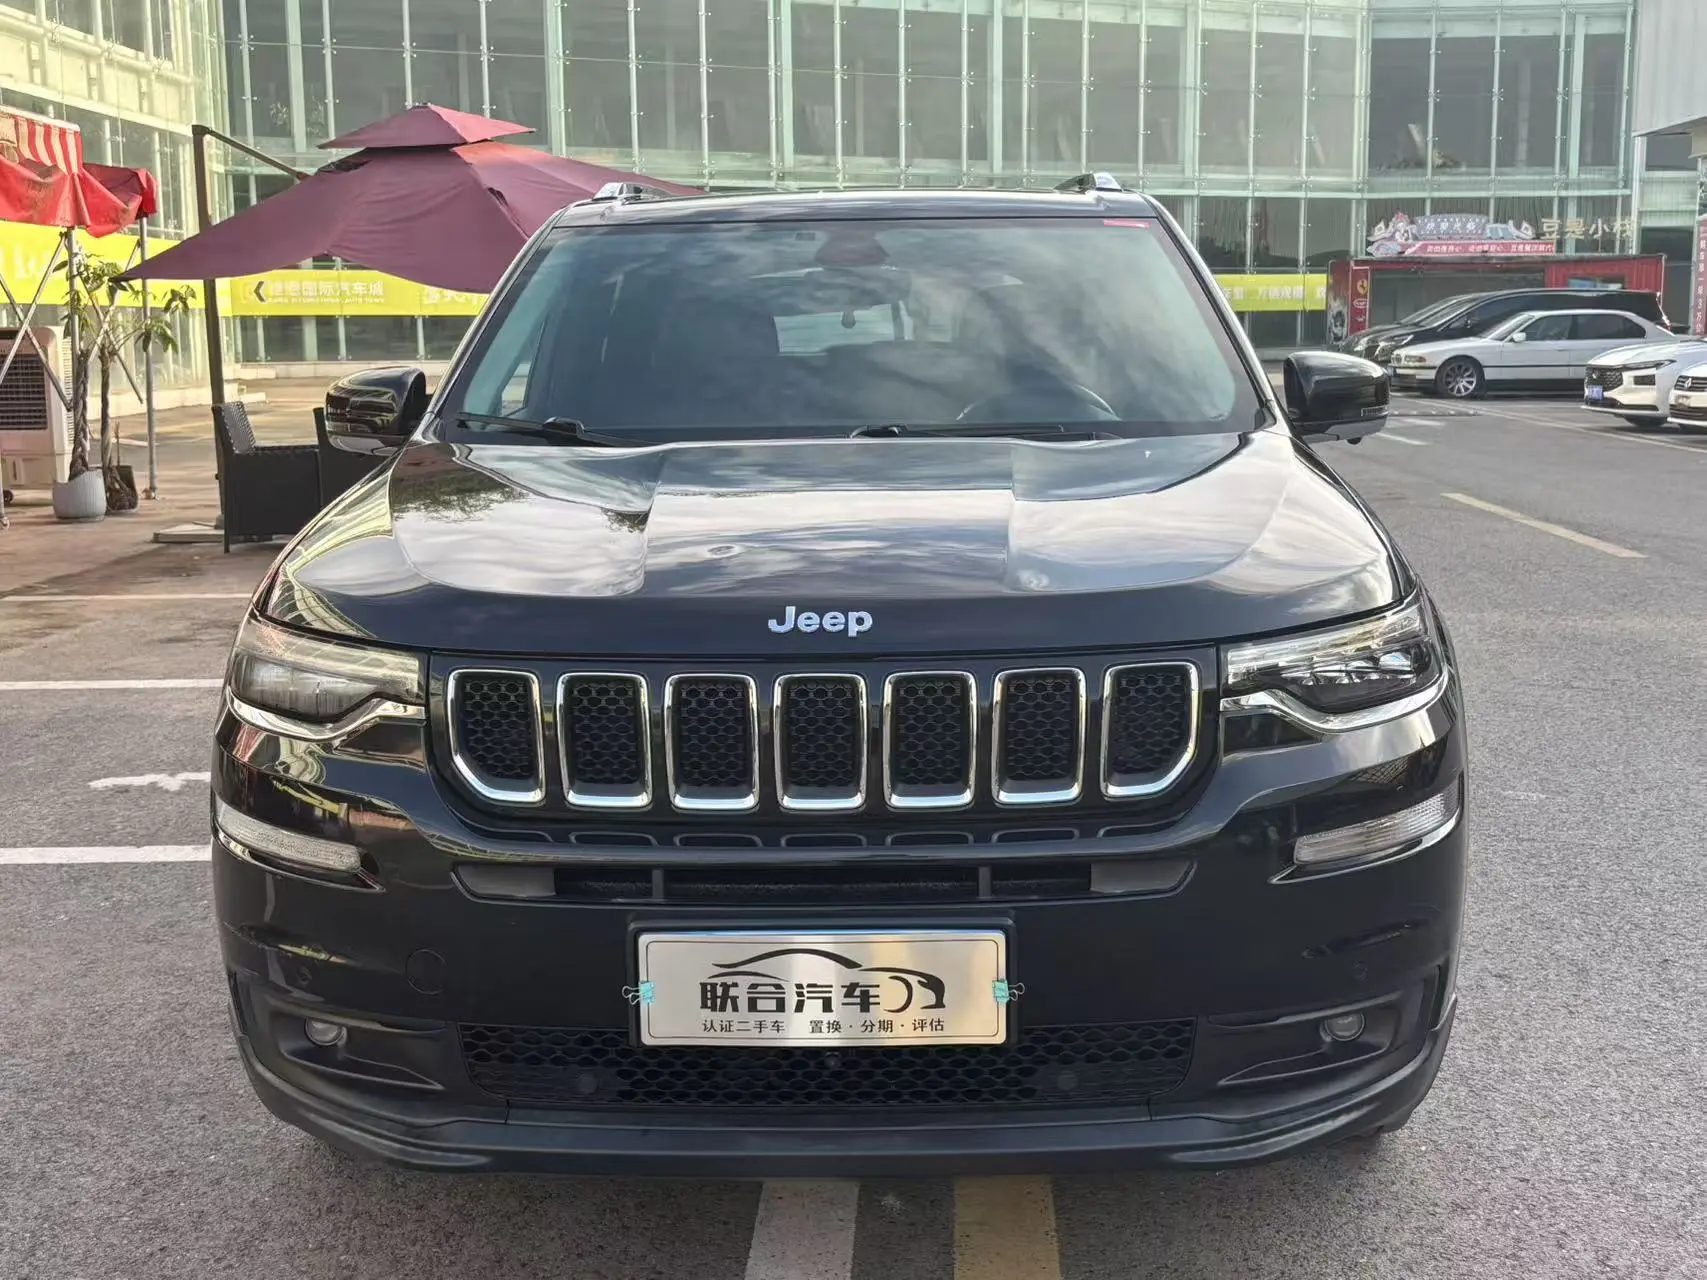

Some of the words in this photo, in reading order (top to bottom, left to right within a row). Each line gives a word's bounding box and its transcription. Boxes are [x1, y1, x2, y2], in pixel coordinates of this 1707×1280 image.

[768, 605, 873, 637] Jeep
[700, 981, 881, 1013] 联合汽车
[702, 1019, 785, 1033] 认证二手车
